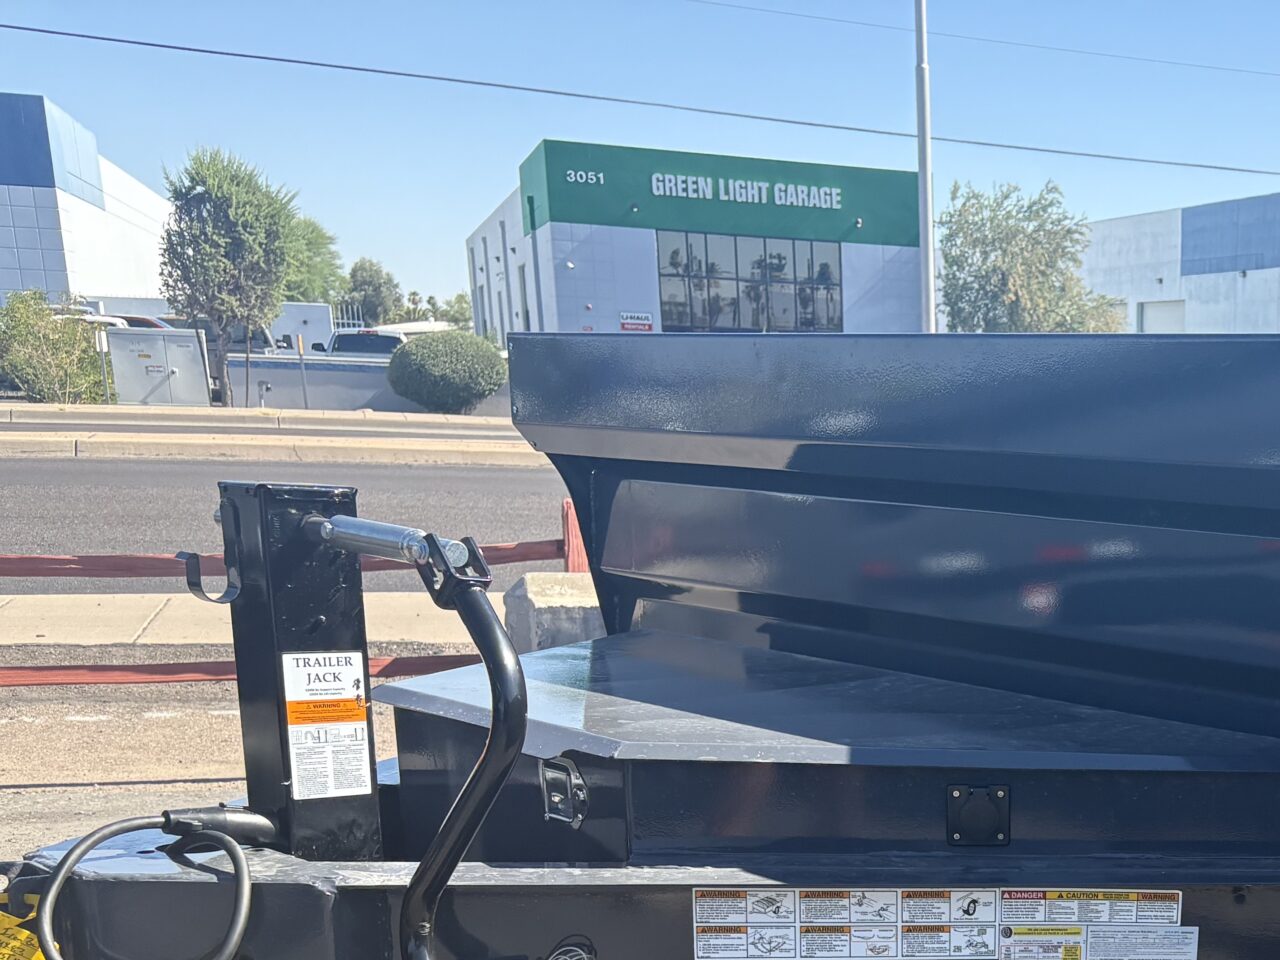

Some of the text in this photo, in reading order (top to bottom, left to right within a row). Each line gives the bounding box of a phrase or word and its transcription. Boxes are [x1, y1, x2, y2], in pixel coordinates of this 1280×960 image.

[566, 170, 605, 185] 3051
[651, 173, 842, 209] GREEN LIGHT GARAGE
[293, 656, 353, 668] TRAILER
[307, 672, 342, 685] JACK
